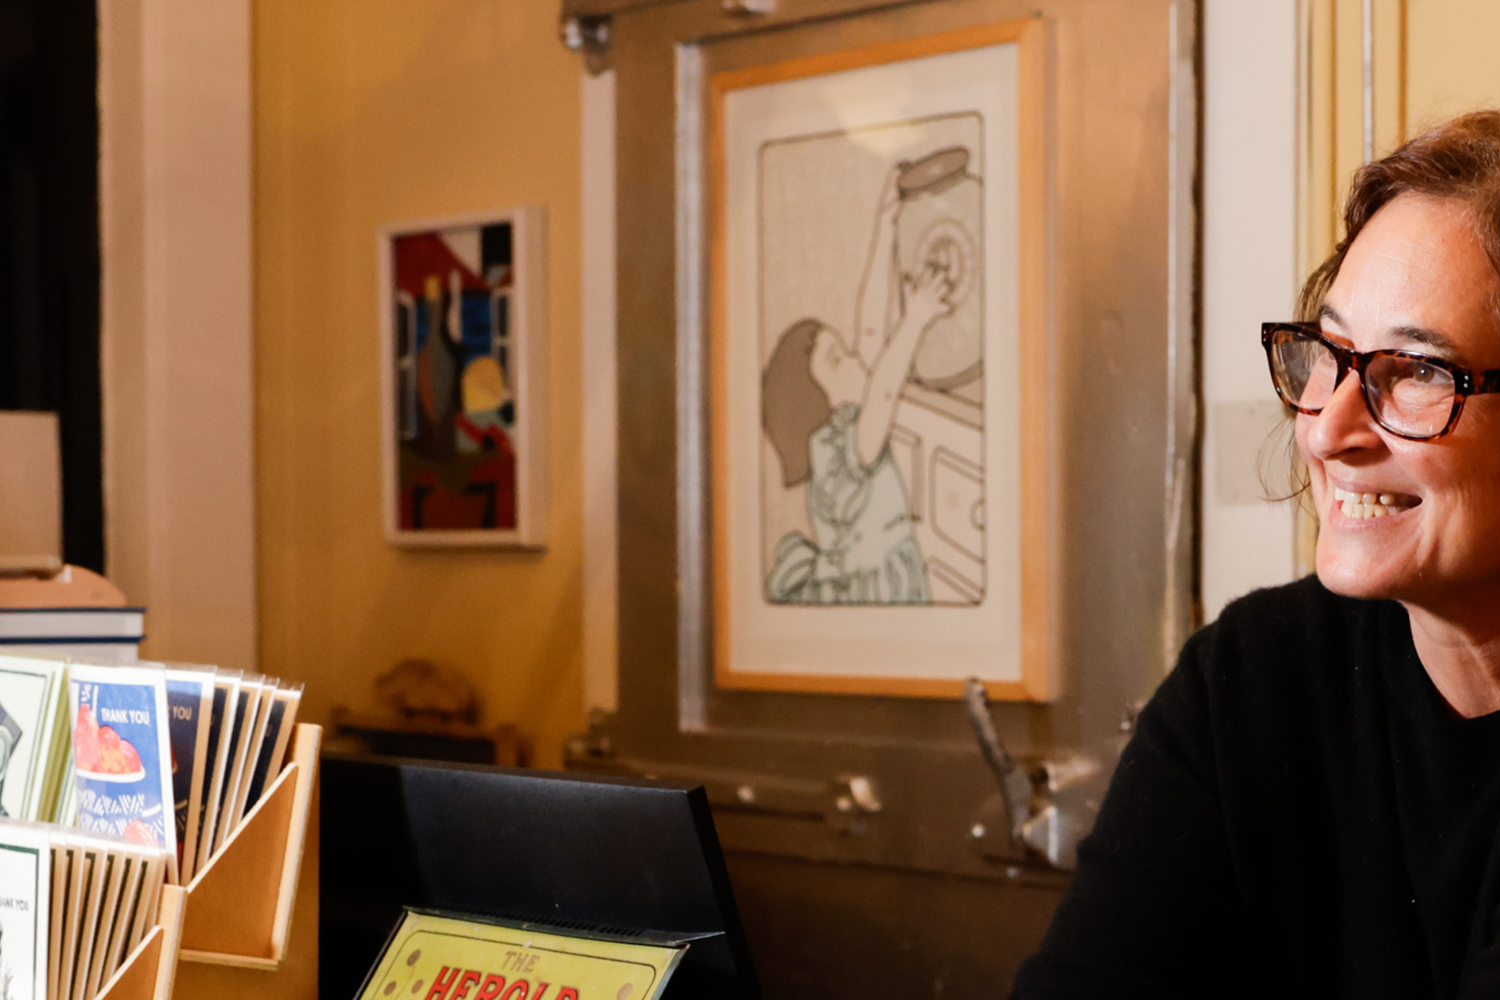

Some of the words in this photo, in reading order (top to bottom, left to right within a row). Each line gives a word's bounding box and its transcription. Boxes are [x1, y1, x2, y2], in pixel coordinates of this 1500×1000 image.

[101, 707, 129, 723] THANK
[129, 709, 150, 725] YOU
[172, 706, 193, 720] YOU
[501, 950, 541, 973] THE
